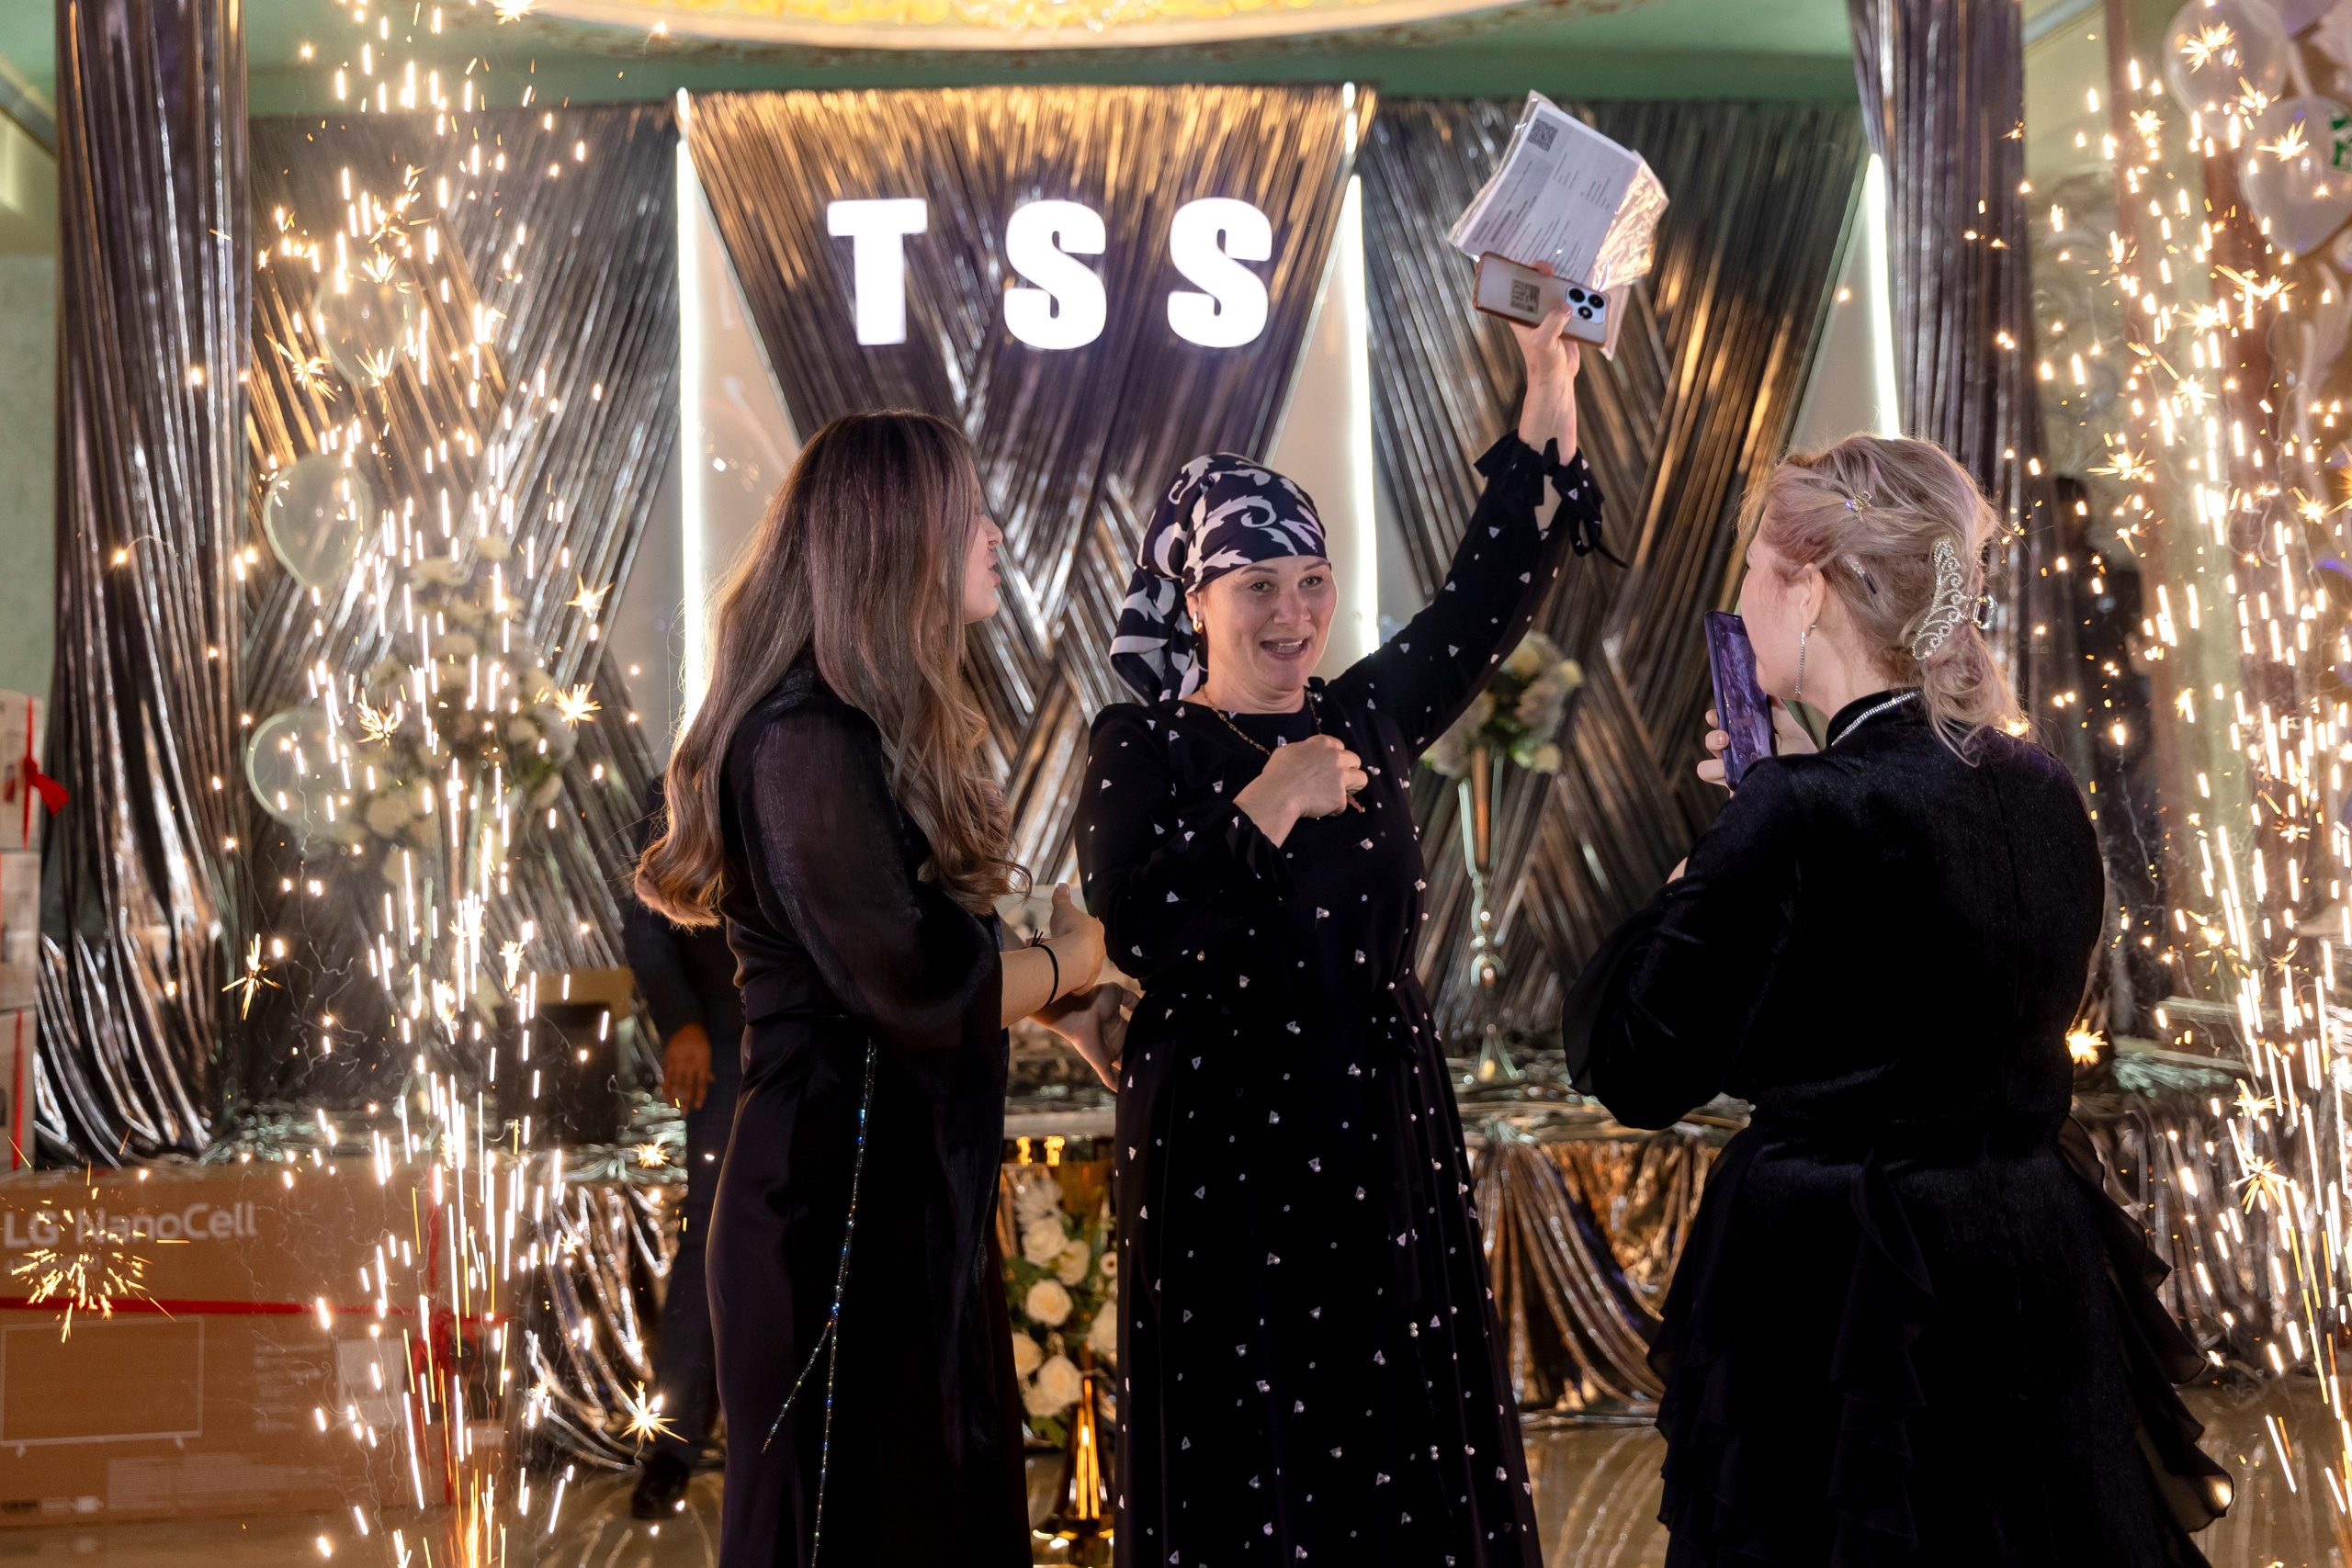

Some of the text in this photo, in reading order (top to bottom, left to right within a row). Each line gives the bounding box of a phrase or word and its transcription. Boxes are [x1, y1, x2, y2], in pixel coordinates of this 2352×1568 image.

[827, 197, 1273, 350] TSS
[4, 1200, 259, 1248] LG NanoCell
